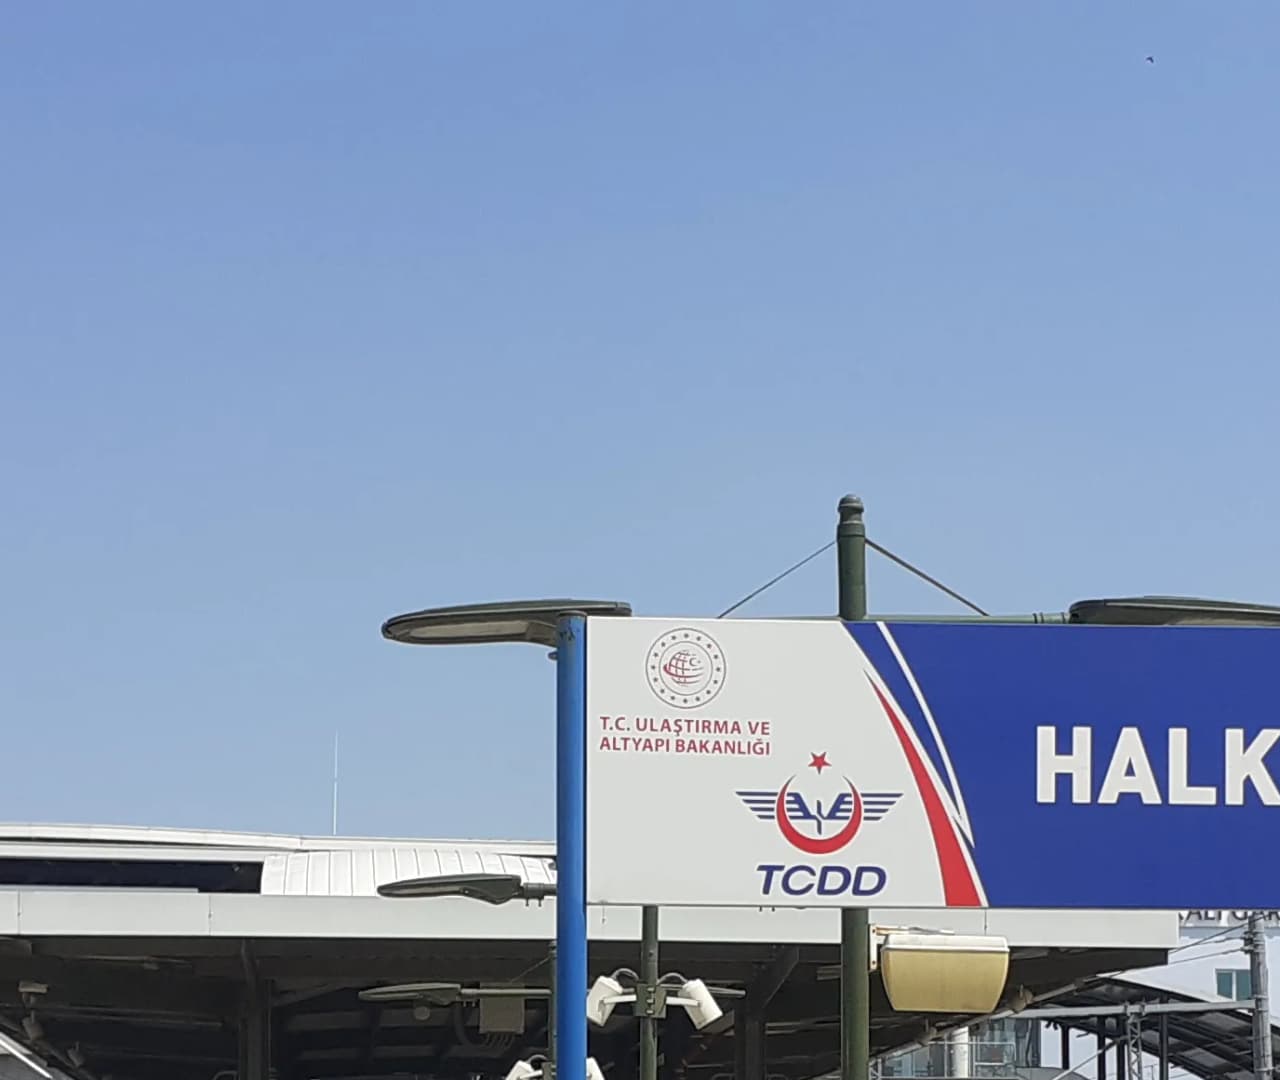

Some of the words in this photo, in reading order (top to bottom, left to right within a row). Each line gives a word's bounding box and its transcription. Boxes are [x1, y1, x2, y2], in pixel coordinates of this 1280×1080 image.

[600, 716, 631, 731] T.C.
[635, 717, 742, 737] ULAŞTIRMA
[748, 721, 771, 735] VE
[600, 736, 671, 753] ALTYAPI
[675, 739, 771, 756] BAKANLIĞI
[756, 864, 887, 897] TCDD
